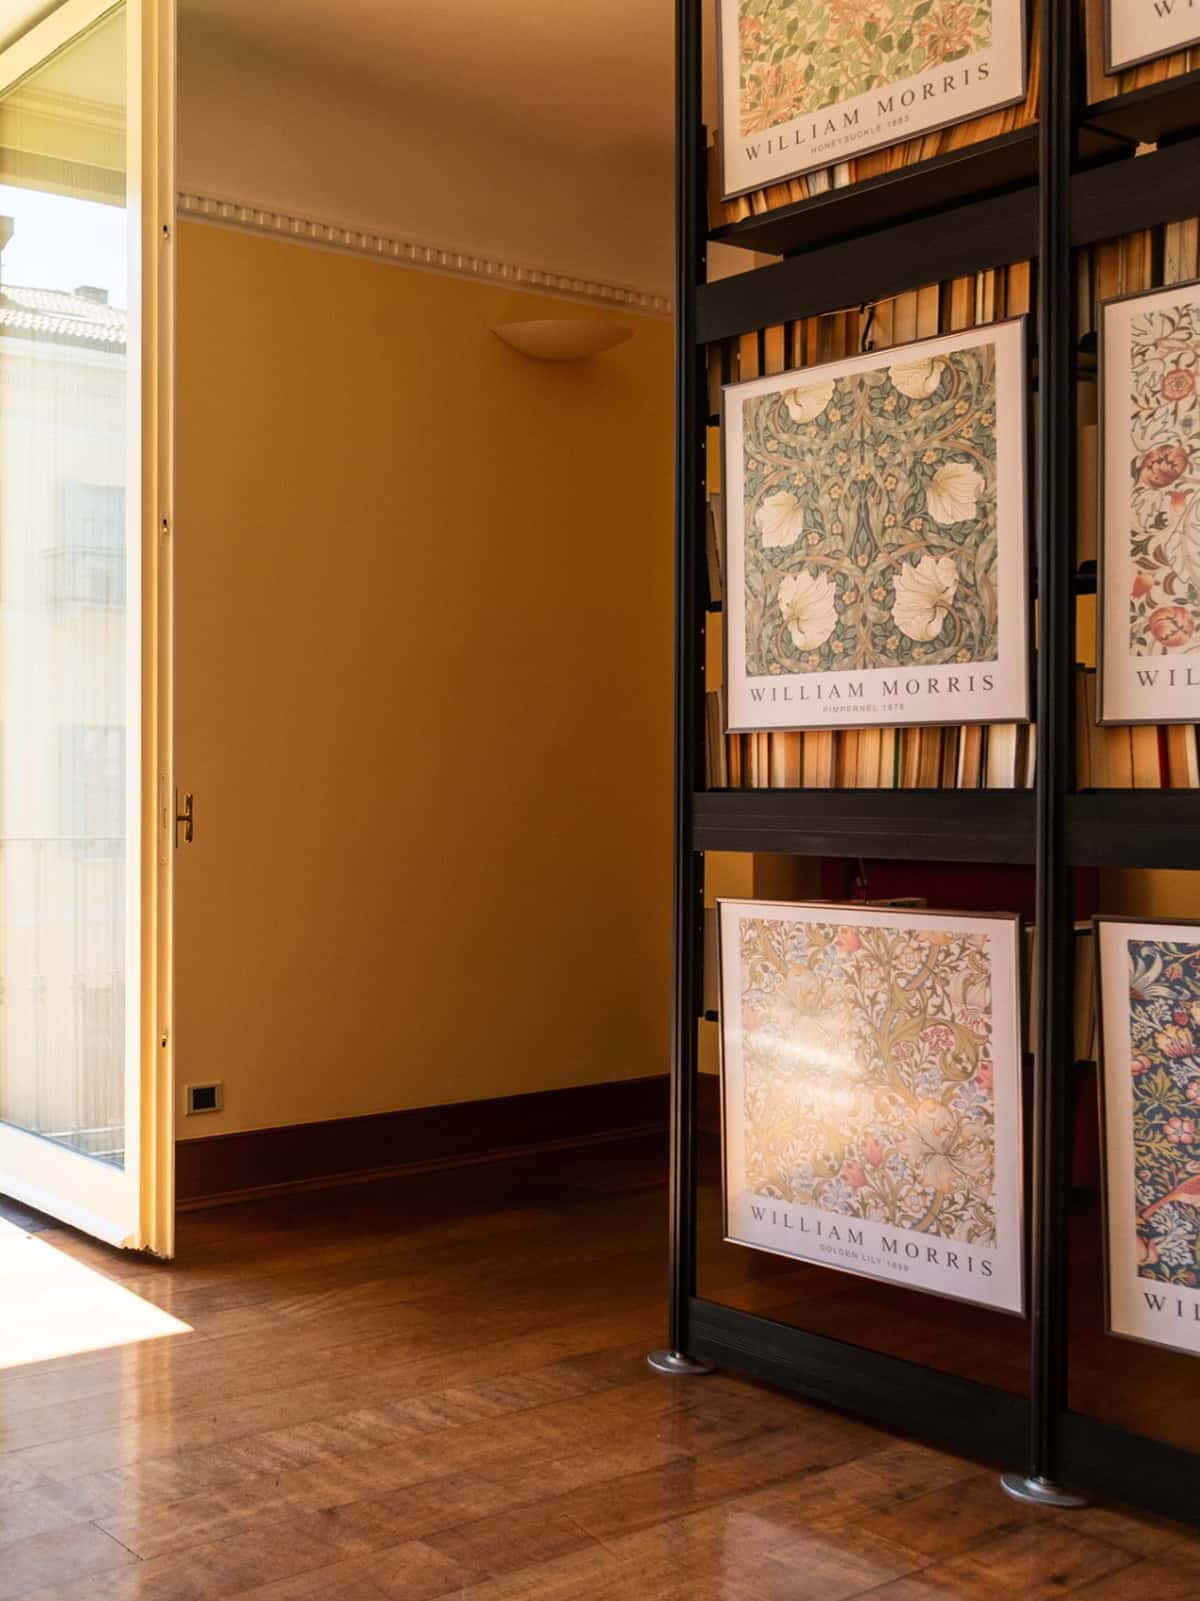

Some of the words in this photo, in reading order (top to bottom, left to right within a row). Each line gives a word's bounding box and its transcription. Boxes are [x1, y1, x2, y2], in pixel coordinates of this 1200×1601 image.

[745, 108, 859, 161] WILLIAM
[877, 62, 991, 116] MORRIS
[750, 683, 864, 701] WILLIAM
[882, 675, 995, 696] MORRIS
[1136, 668, 1200, 687] WIL
[751, 1206, 864, 1246] WILLIAM
[881, 1236, 993, 1277] MORRIS
